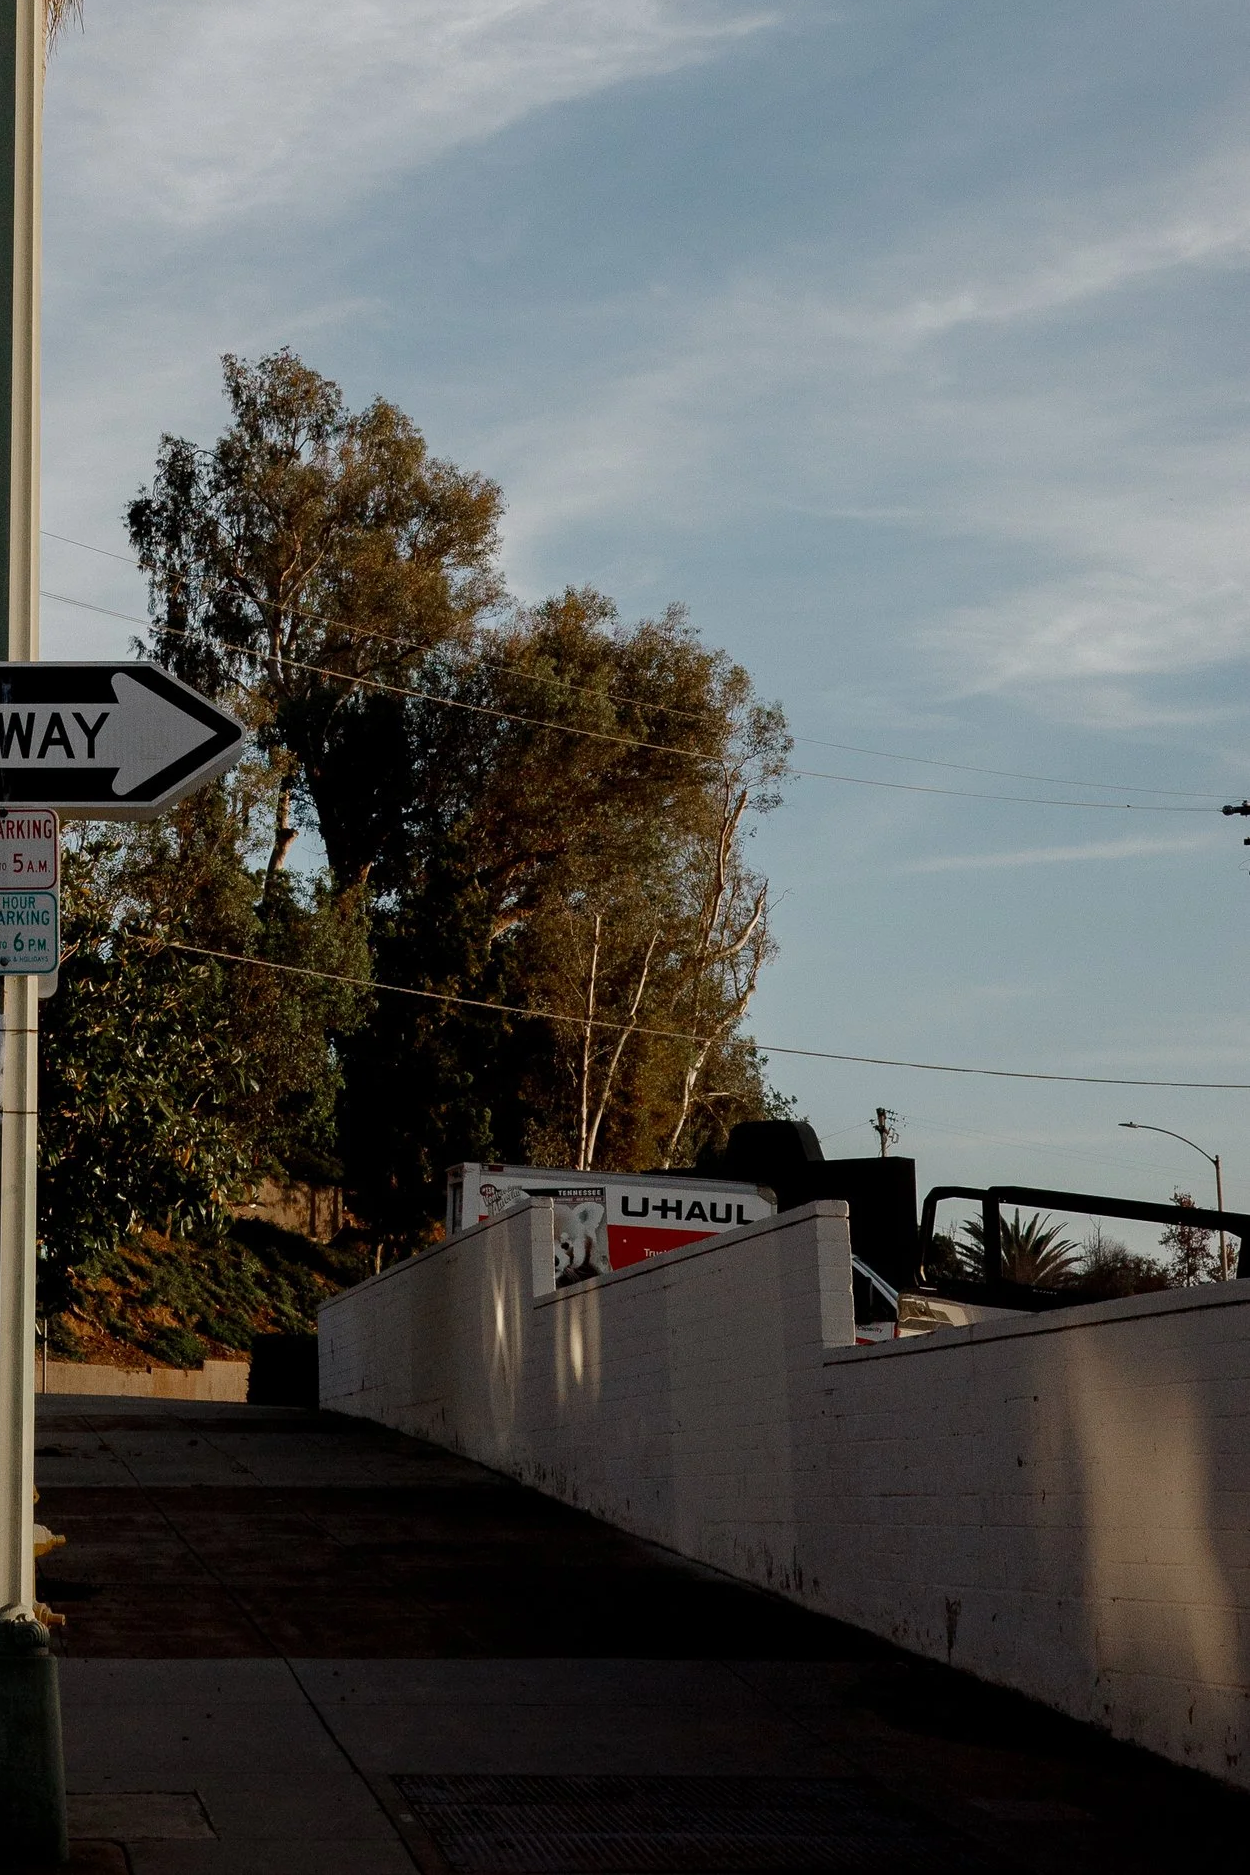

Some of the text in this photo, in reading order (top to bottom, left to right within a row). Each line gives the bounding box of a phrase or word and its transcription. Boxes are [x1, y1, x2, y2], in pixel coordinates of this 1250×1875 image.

[2, 896, 36, 910] HOUR
[0, 941, 8, 950] TO
[19, 955, 49, 963] HOLIDAYS
[557, 1189, 602, 1197] TENNESSEE
[621, 1196, 754, 1225] U-HAUL
